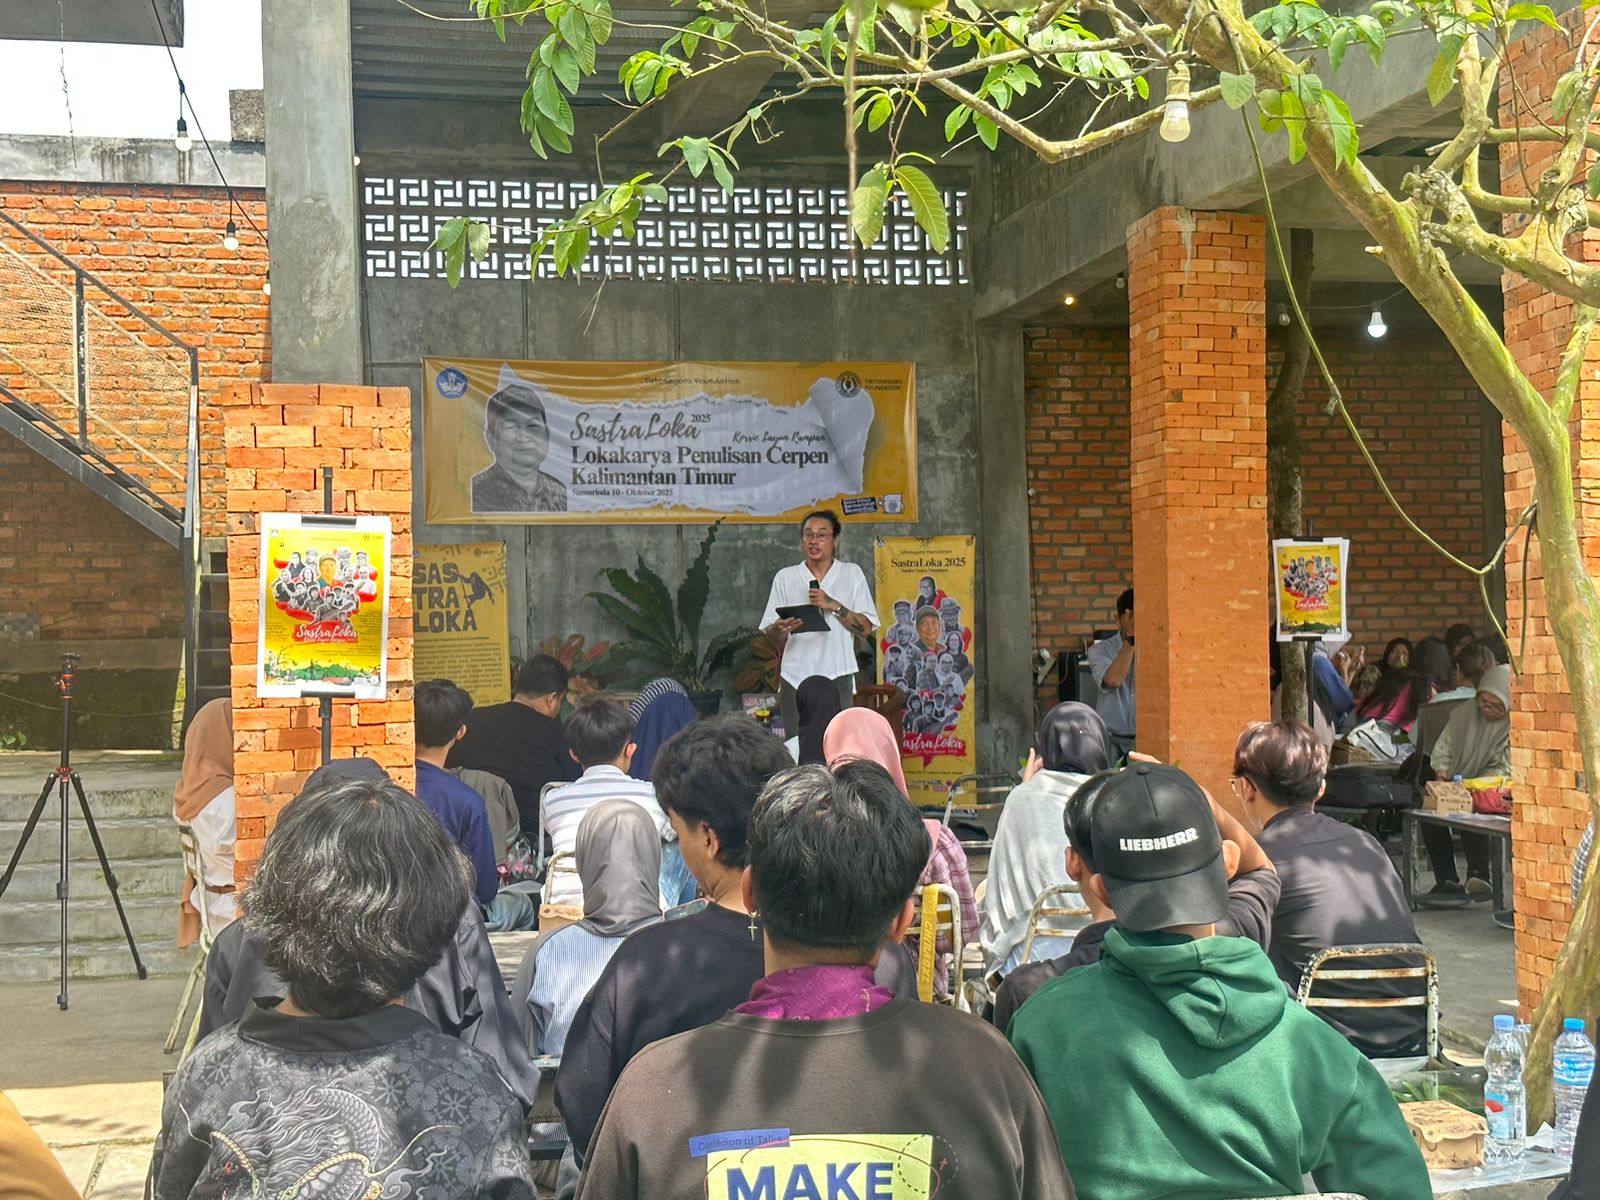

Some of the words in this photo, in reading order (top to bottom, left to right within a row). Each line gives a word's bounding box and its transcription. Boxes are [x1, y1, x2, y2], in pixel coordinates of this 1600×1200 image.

[691, 414, 712, 423] 2025
[570, 446, 672, 468] Lokakarya
[677, 446, 762, 465] Penulisan
[766, 446, 829, 468] Cerpen
[571, 467, 676, 485] Kalimantan
[681, 467, 737, 485] Timur
[572, 488, 610, 496] Samarinda
[612, 488, 620, 496] 10
[626, 488, 655, 496] Oktober
[657, 488, 673, 496] 2025
[891, 557, 942, 568] SastraLoka
[944, 557, 966, 567] 2025
[413, 562, 460, 584] SAS
[413, 586, 460, 609] TRA
[413, 609, 477, 633] LOKA
[902, 732, 965, 750] astraLoka
[1119, 827, 1199, 851] LIEBHERR
[744, 1137, 754, 1145] of
[726, 1162, 894, 1200] MAKE
